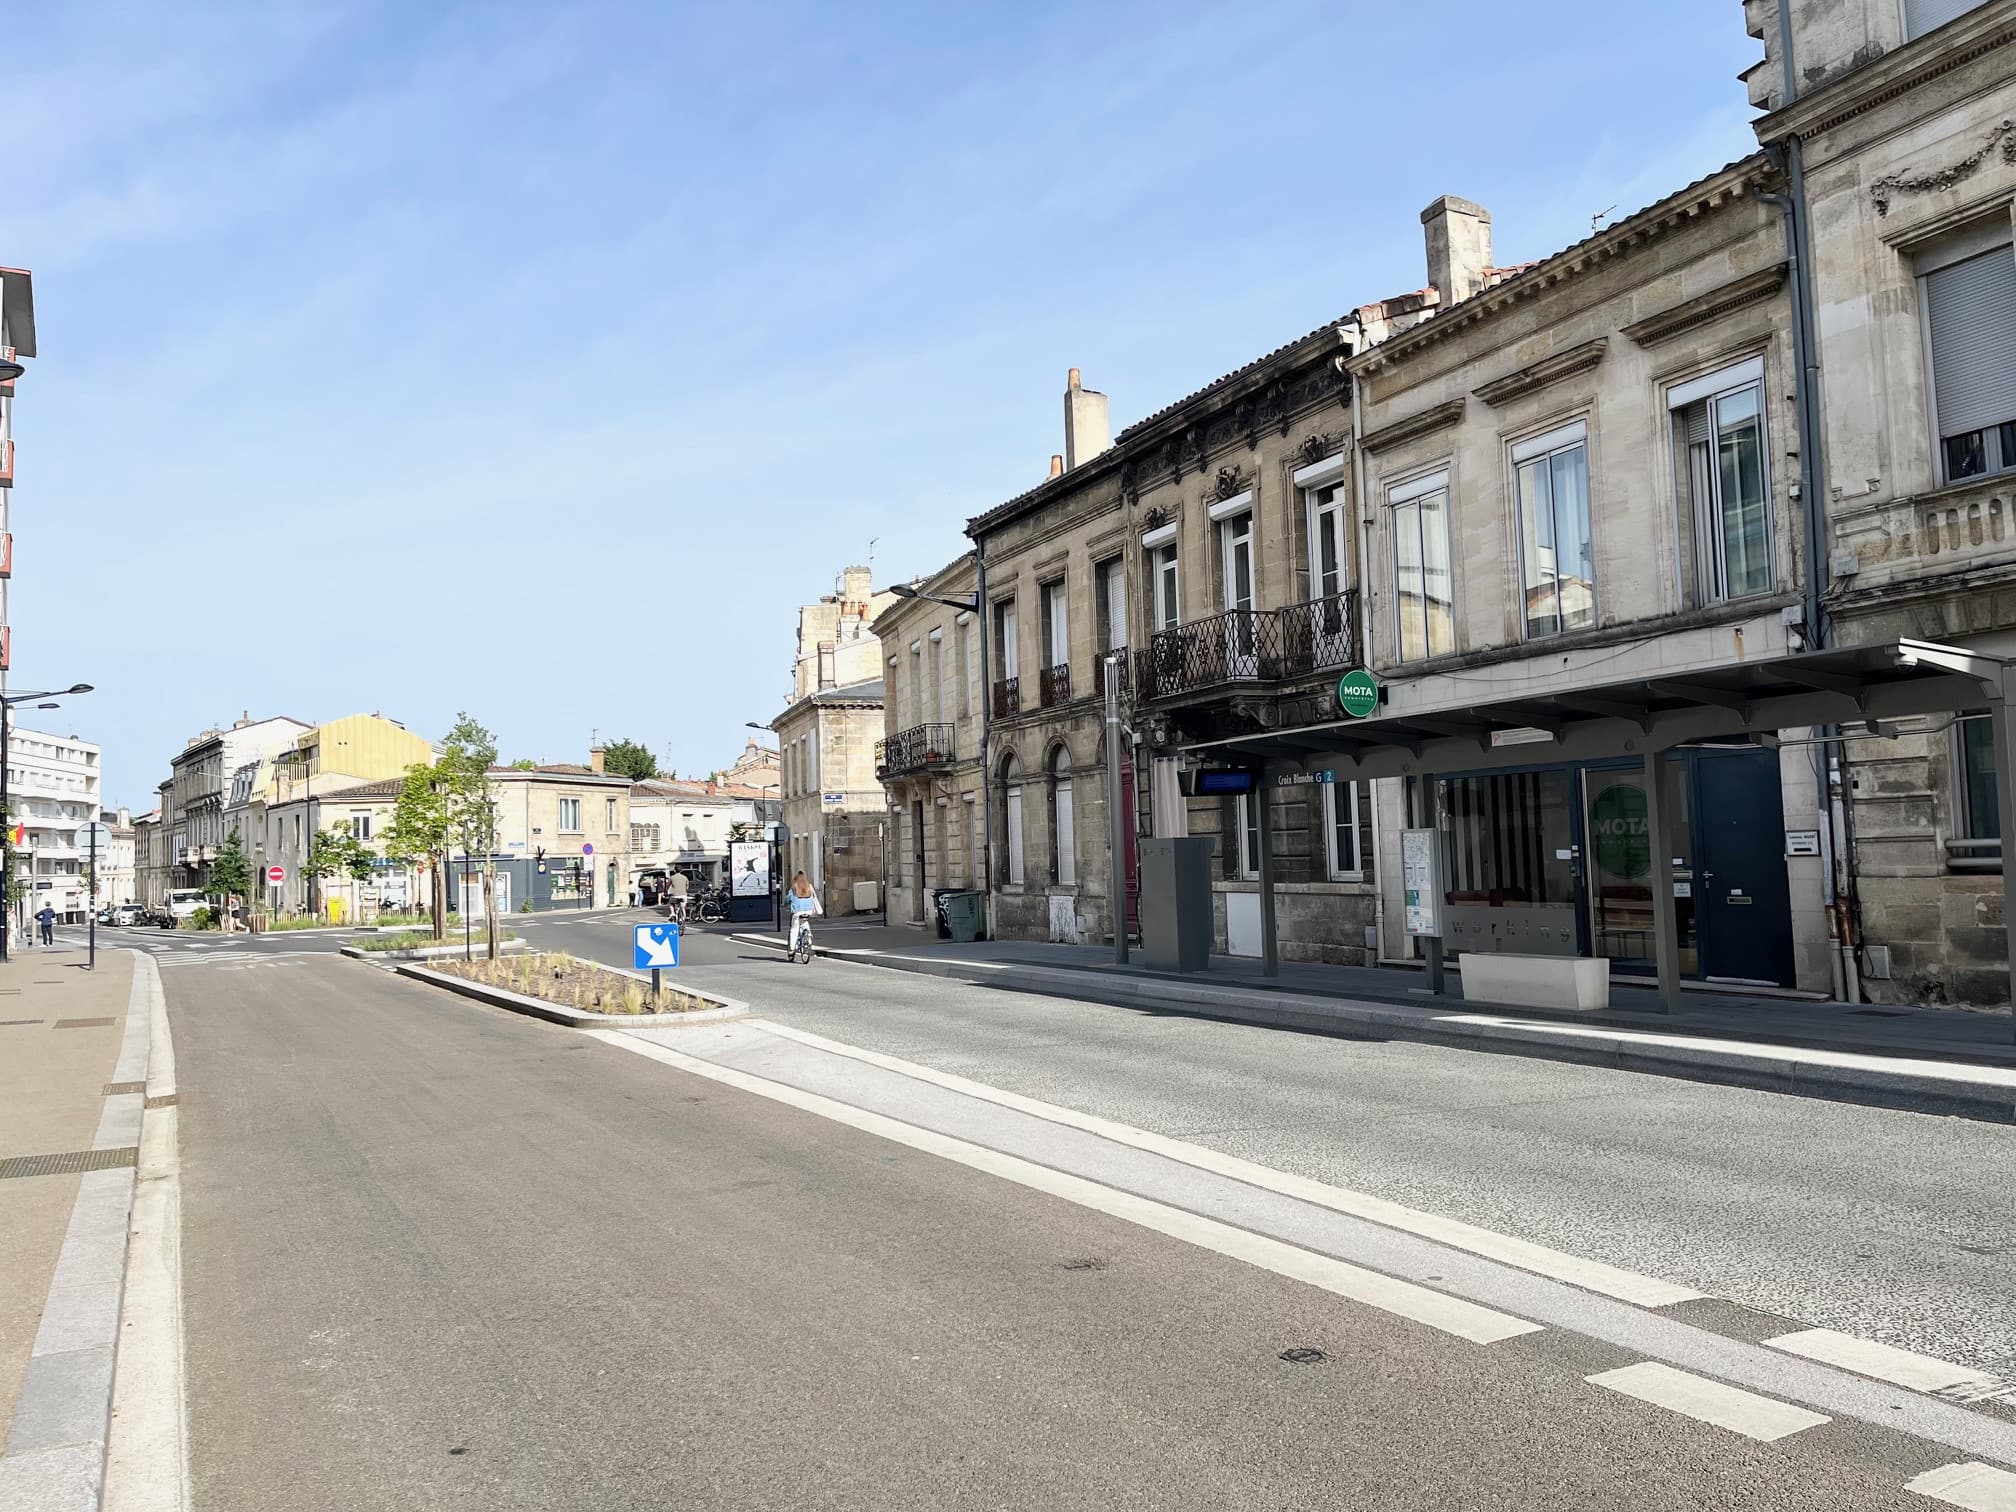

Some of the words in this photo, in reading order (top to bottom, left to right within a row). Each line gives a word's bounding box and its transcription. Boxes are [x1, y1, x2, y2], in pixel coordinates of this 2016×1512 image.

[1344, 685, 1373, 697] MOTA
[1278, 774, 1292, 785] Croix
[1315, 772, 1322, 783] G
[1595, 817, 1648, 836] MOTA
